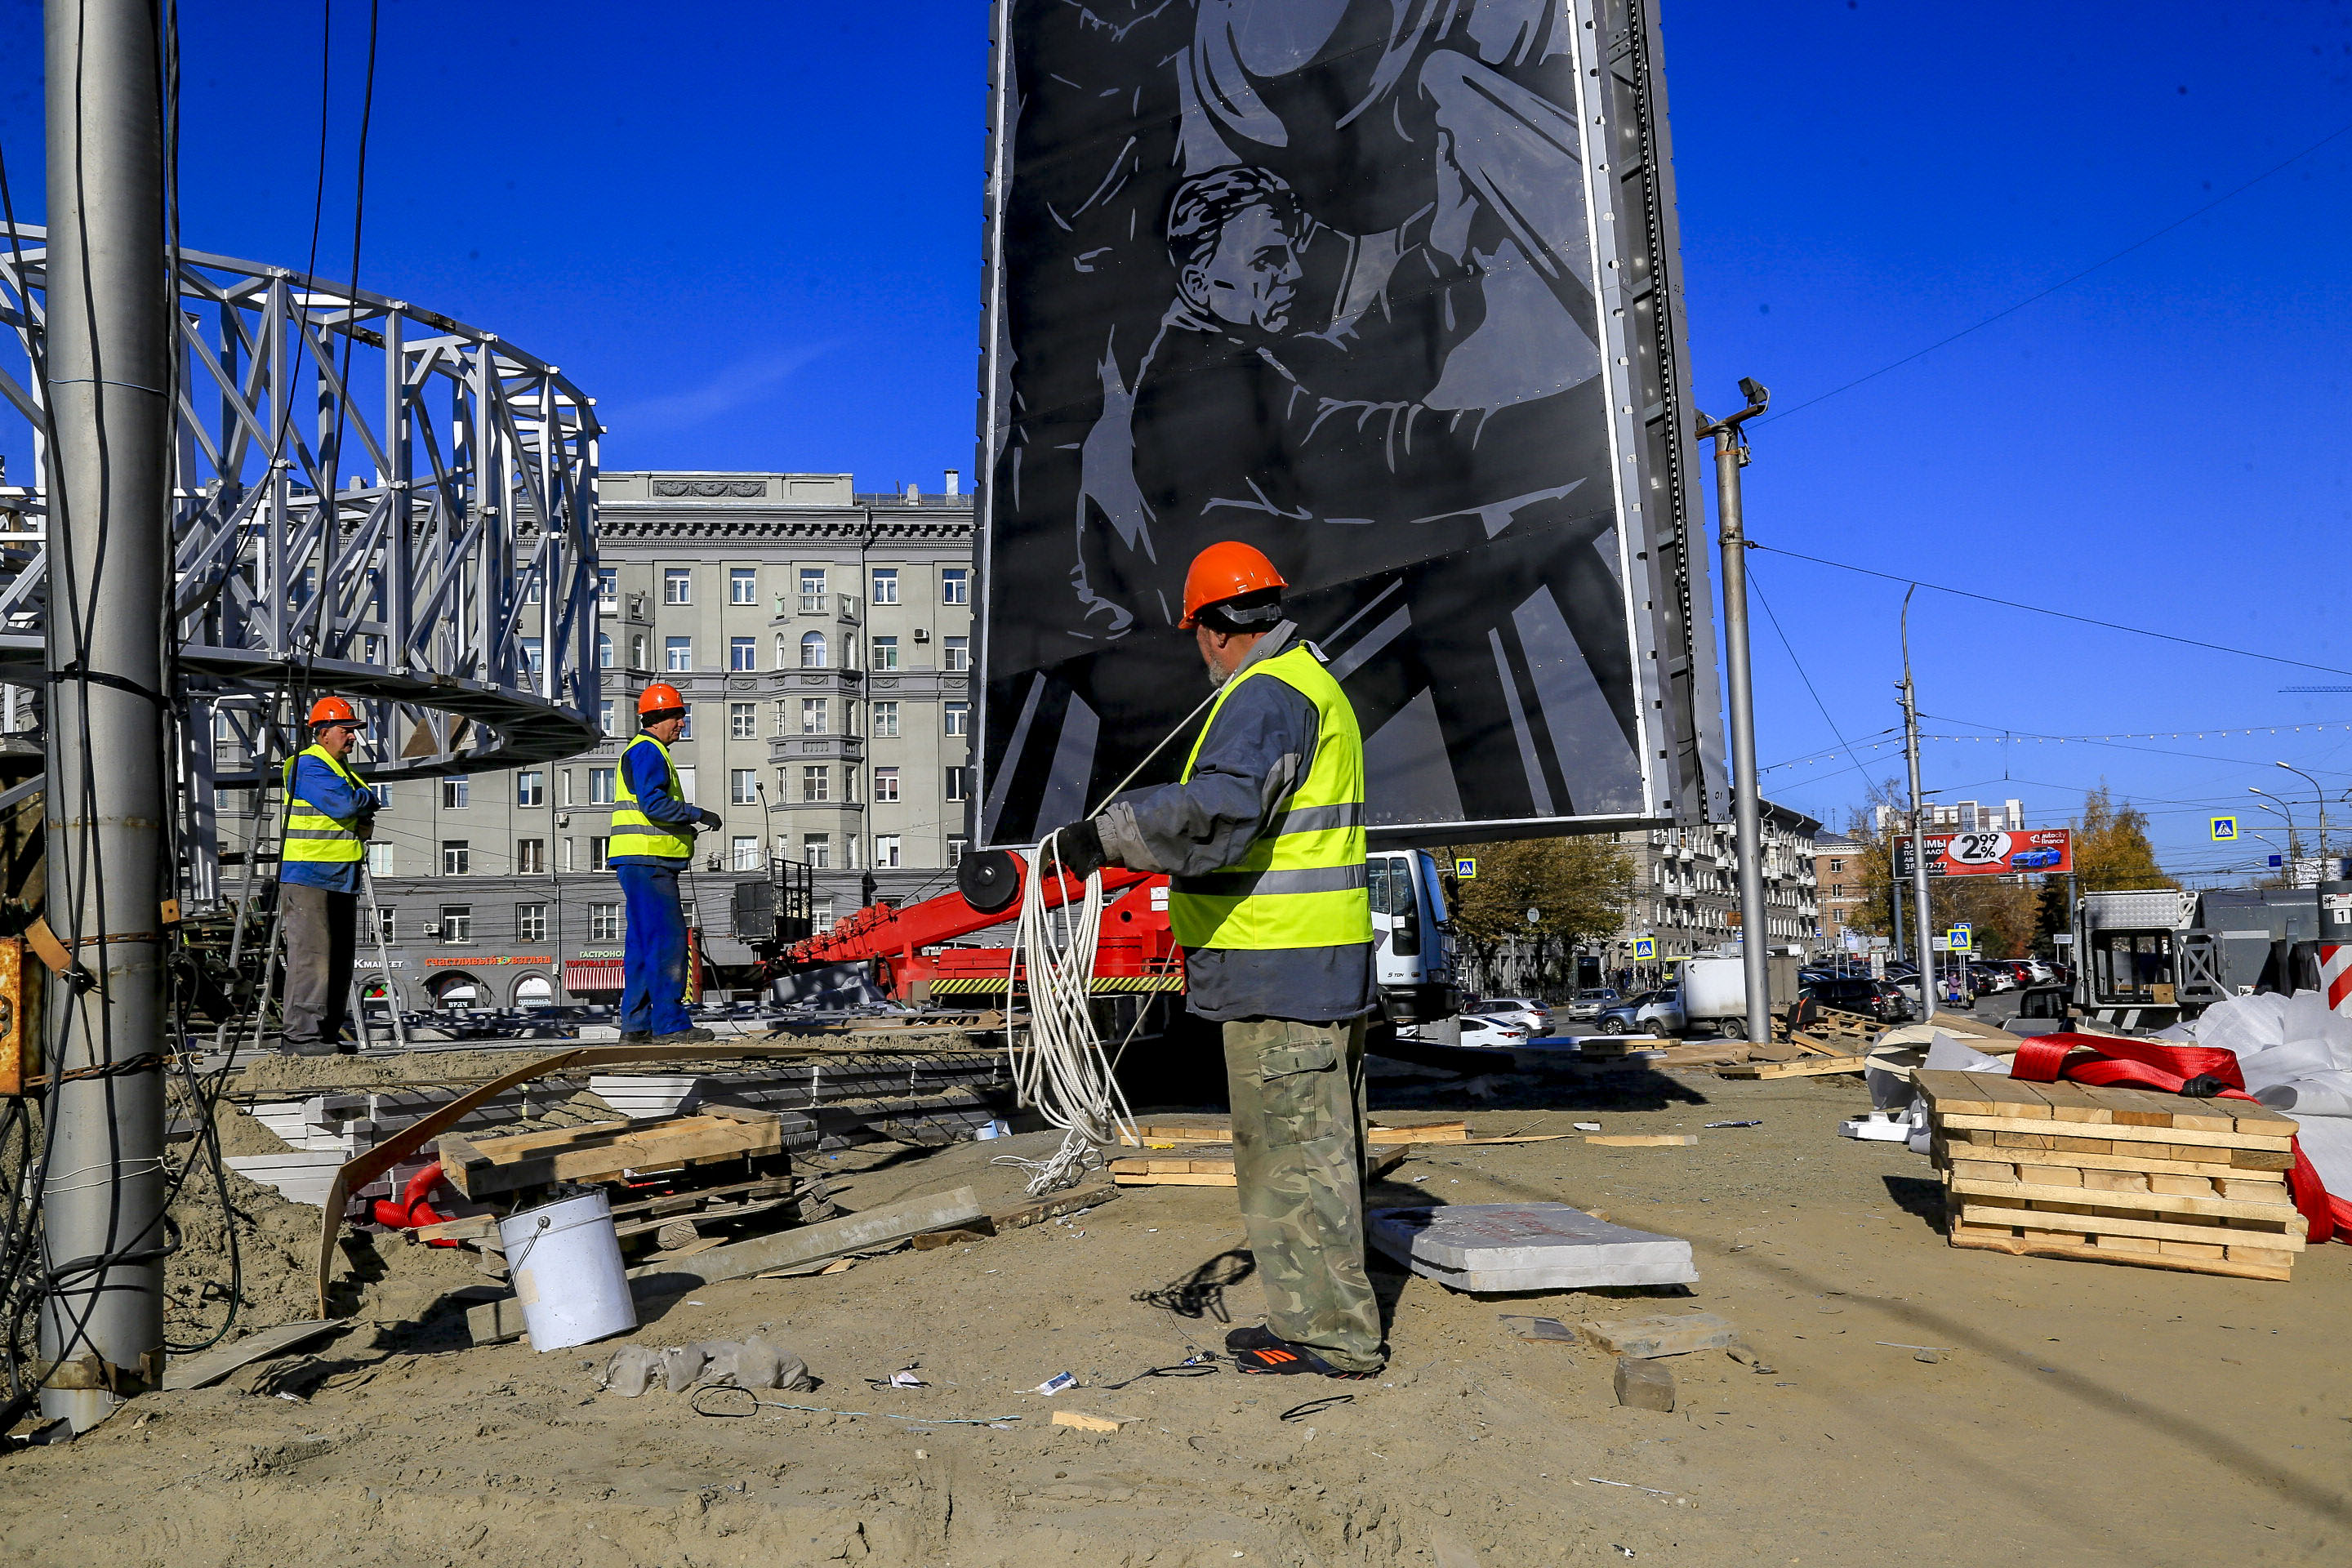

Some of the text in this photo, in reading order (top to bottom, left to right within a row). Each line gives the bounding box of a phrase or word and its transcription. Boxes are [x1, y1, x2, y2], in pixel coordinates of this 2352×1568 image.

[1961, 835, 1981, 858] 2
[2338, 911, 2345, 922] 1
[425, 956, 551, 966] счастливый взгляд
[565, 960, 605, 968] ТОРГОВАЯ
